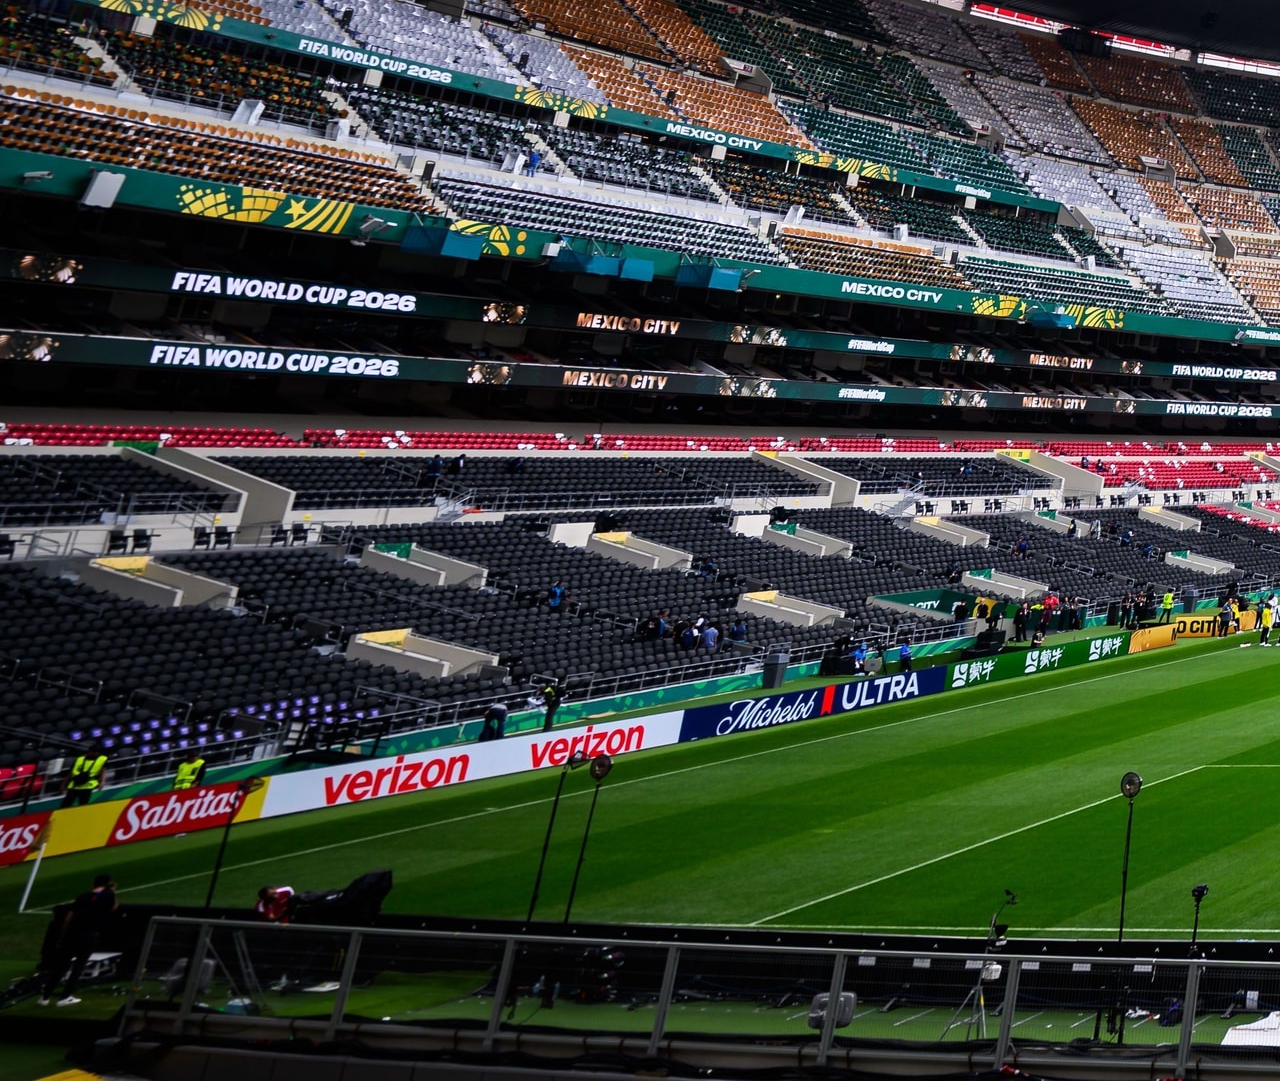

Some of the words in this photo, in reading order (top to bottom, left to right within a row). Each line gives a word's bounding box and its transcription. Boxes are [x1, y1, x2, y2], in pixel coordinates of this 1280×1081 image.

[299, 39, 328, 57] FIFA
[331, 43, 379, 67] WORLD
[380, 54, 407, 72] CUP
[406, 66, 452, 83] 2026
[666, 123, 726, 143] MEXICO
[728, 137, 763, 151] CITY
[172, 272, 221, 293] FIFA
[225, 277, 304, 300] WORLD
[305, 286, 347, 305] CUP
[347, 290, 416, 311] 2026
[841, 282, 904, 299] MEXICO
[906, 289, 943, 303] CITY
[576, 313, 641, 332] MEXICO
[643, 319, 681, 335] CITY
[150, 345, 201, 366] FIFA
[205, 348, 284, 370] WORLD
[285, 356, 329, 373] CUP
[329, 357, 399, 377] 2026
[1029, 354, 1069, 368] MEXICO
[1070, 357, 1093, 370] CITY
[1172, 365, 1191, 376] FIFA
[1192, 366, 1223, 378] WORLD
[1224, 368, 1244, 379] CUP
[1243, 370, 1277, 381] 2026
[563, 371, 628, 388] MEXICO
[630, 375, 668, 390] CITY
[1022, 397, 1063, 409] MEXICO
[1063, 398, 1087, 410] CITY
[1166, 404, 1186, 415] FIFA
[1186, 404, 1218, 415] WORLD
[1218, 405, 1238, 416] CUP
[1237, 407, 1272, 418] 2026
[915, 599, 941, 610] CITY
[1040, 646, 1066, 670] 蒙牛
[1102, 635, 1125, 657] 蒙牛
[968, 658, 997, 683] 蒙牛
[716, 691, 819, 737] Michelob
[842, 672, 920, 712] ULTRA
[530, 725, 645, 769] verizon
[324, 753, 471, 807] verizon
[115, 788, 244, 842] Sabritas
